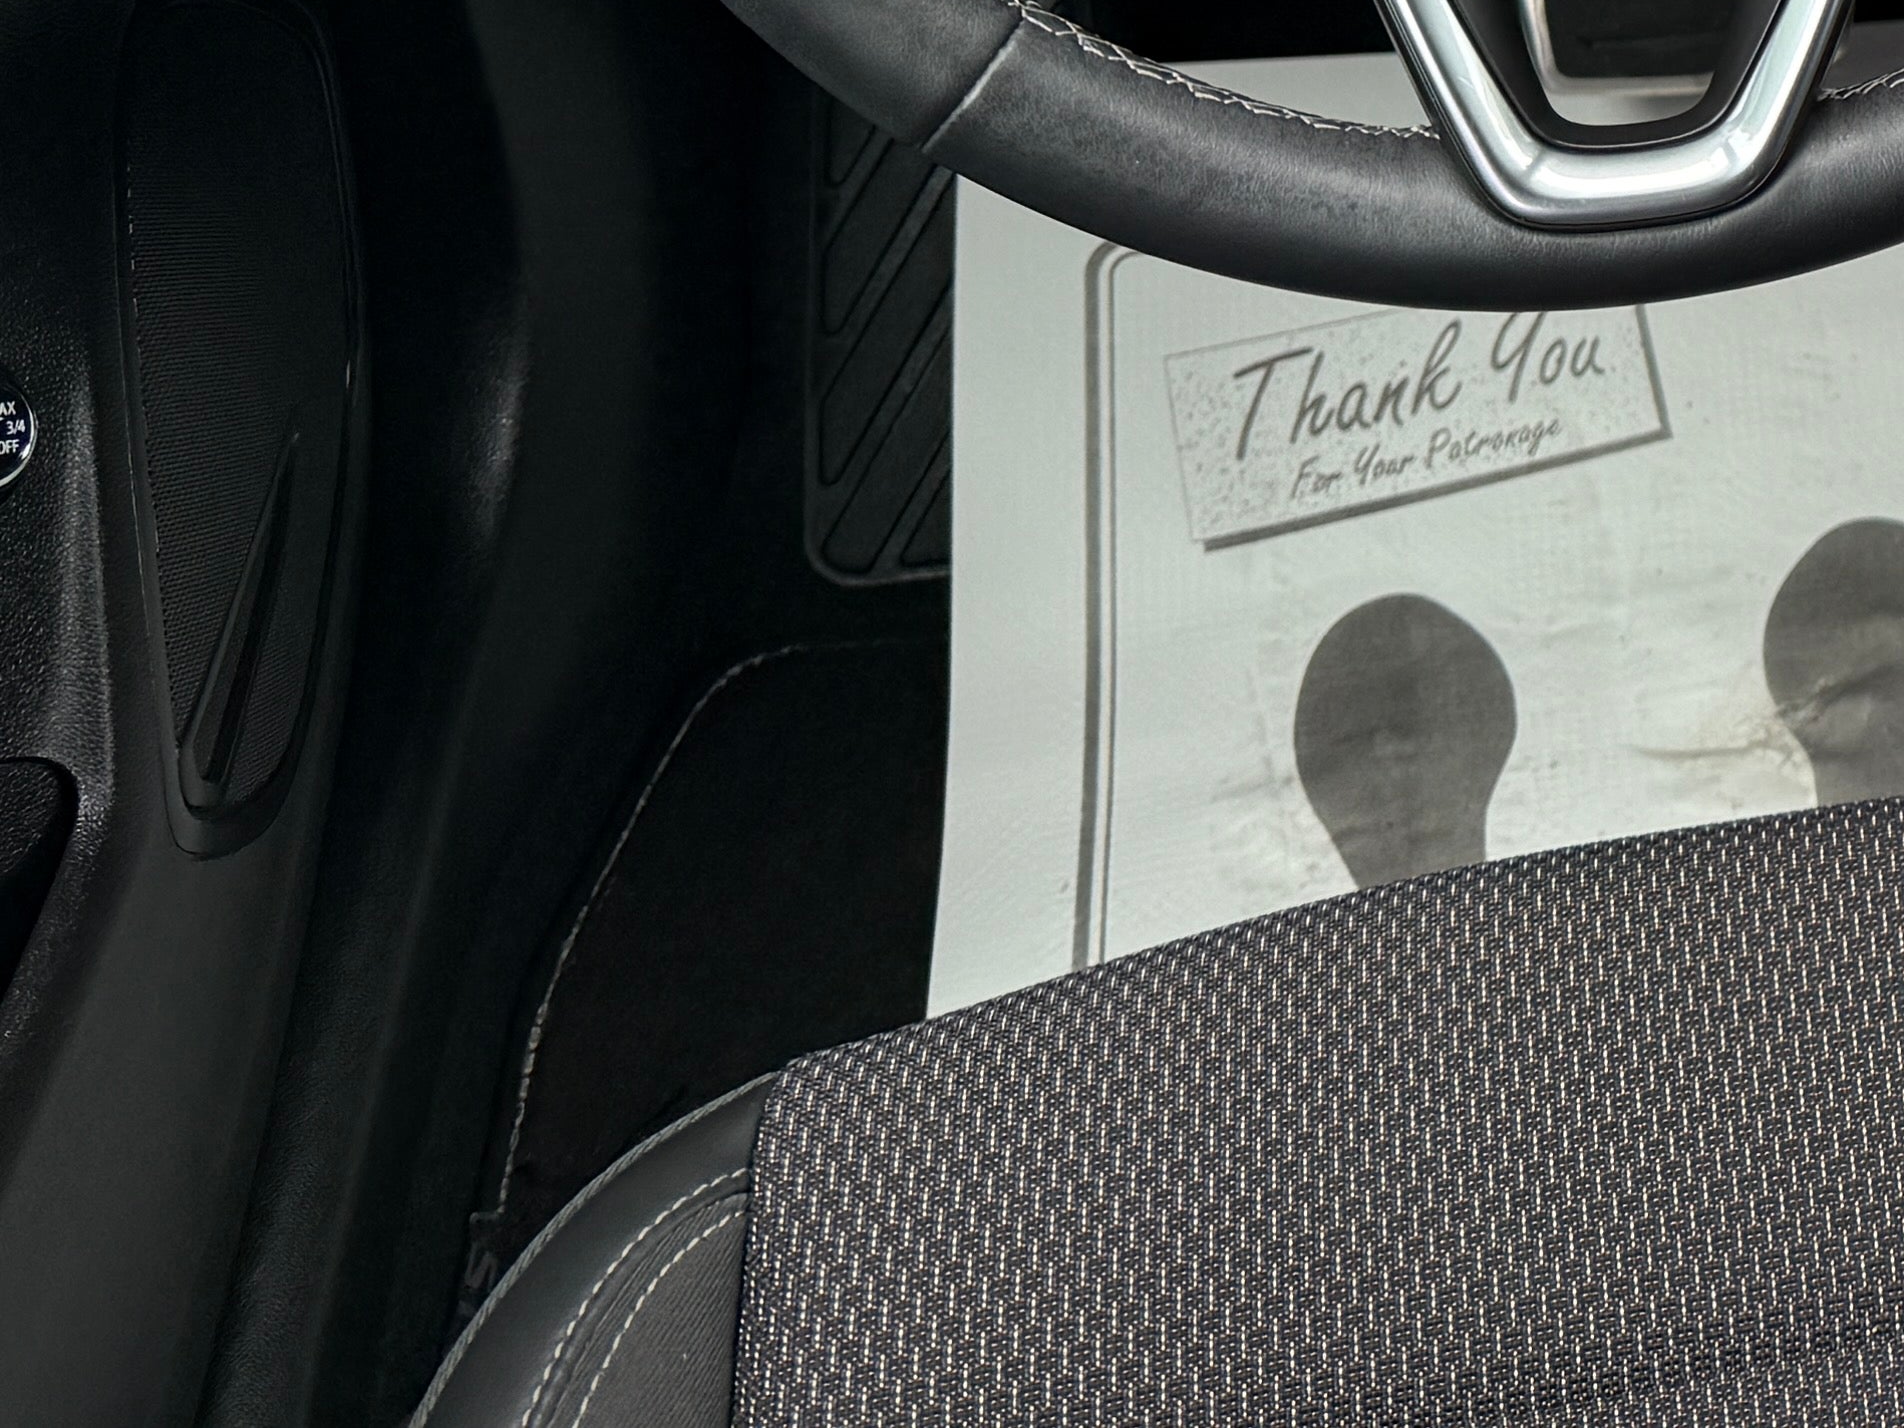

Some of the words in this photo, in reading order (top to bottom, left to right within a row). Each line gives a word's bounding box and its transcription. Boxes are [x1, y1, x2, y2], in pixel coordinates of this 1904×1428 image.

[1233, 318, 1463, 462] Thank
[1490, 310, 1605, 404] You
[6, 419, 26, 436] 3/4
[1290, 460, 1341, 500] For
[1353, 445, 1413, 486] Your
[1425, 418, 1562, 470] Patronage
